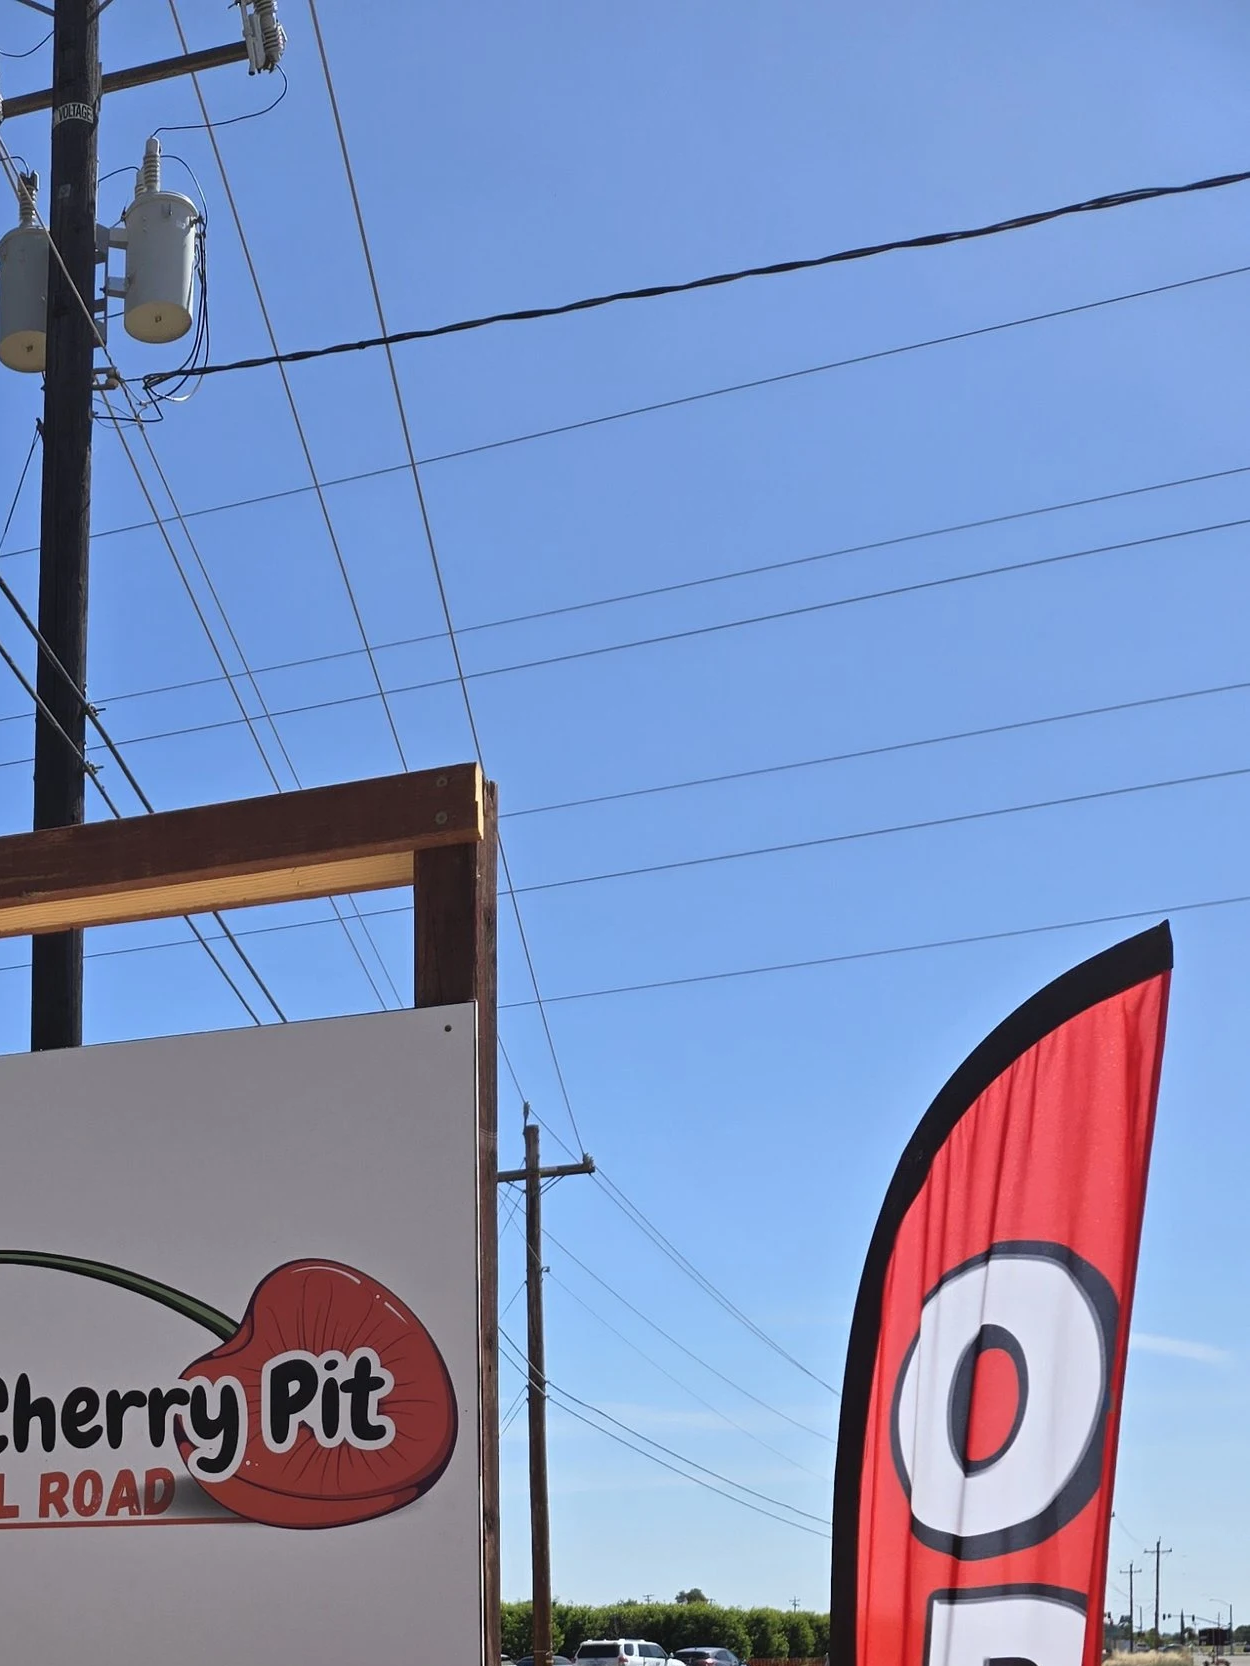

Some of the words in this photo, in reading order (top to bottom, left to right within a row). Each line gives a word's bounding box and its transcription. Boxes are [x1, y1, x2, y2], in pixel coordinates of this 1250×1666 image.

[59, 103, 93, 122] VOLTAGE
[269, 1356, 387, 1444] Pit
[39, 1468, 175, 1517] ROAD
